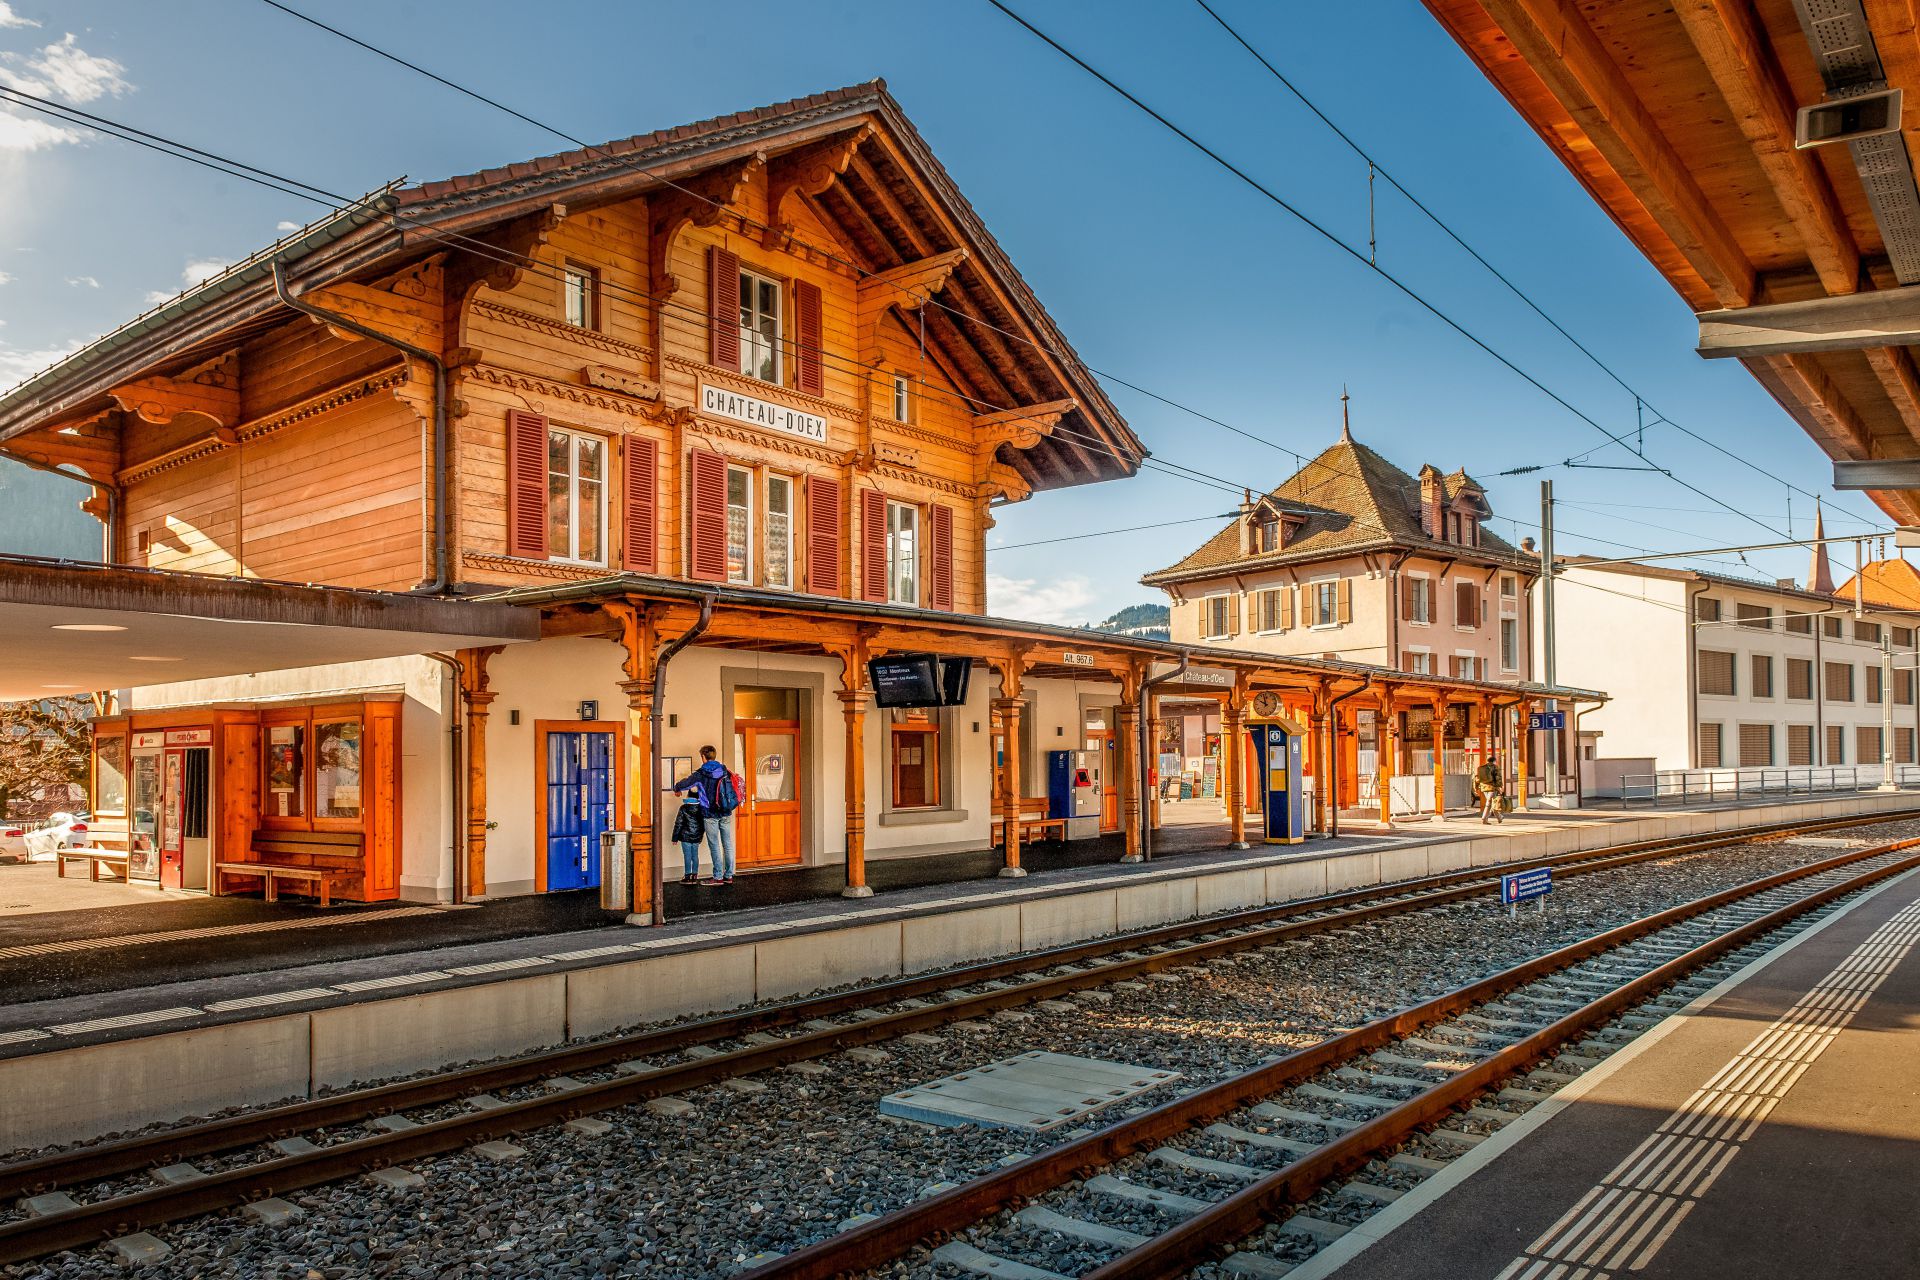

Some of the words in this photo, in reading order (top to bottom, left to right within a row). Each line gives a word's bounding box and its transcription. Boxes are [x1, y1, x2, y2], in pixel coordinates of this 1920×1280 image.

[706, 389, 822, 438] CHATEAU-D'OEX
[1531, 718, 1541, 728] B
[1551, 717, 1557, 727] 1
